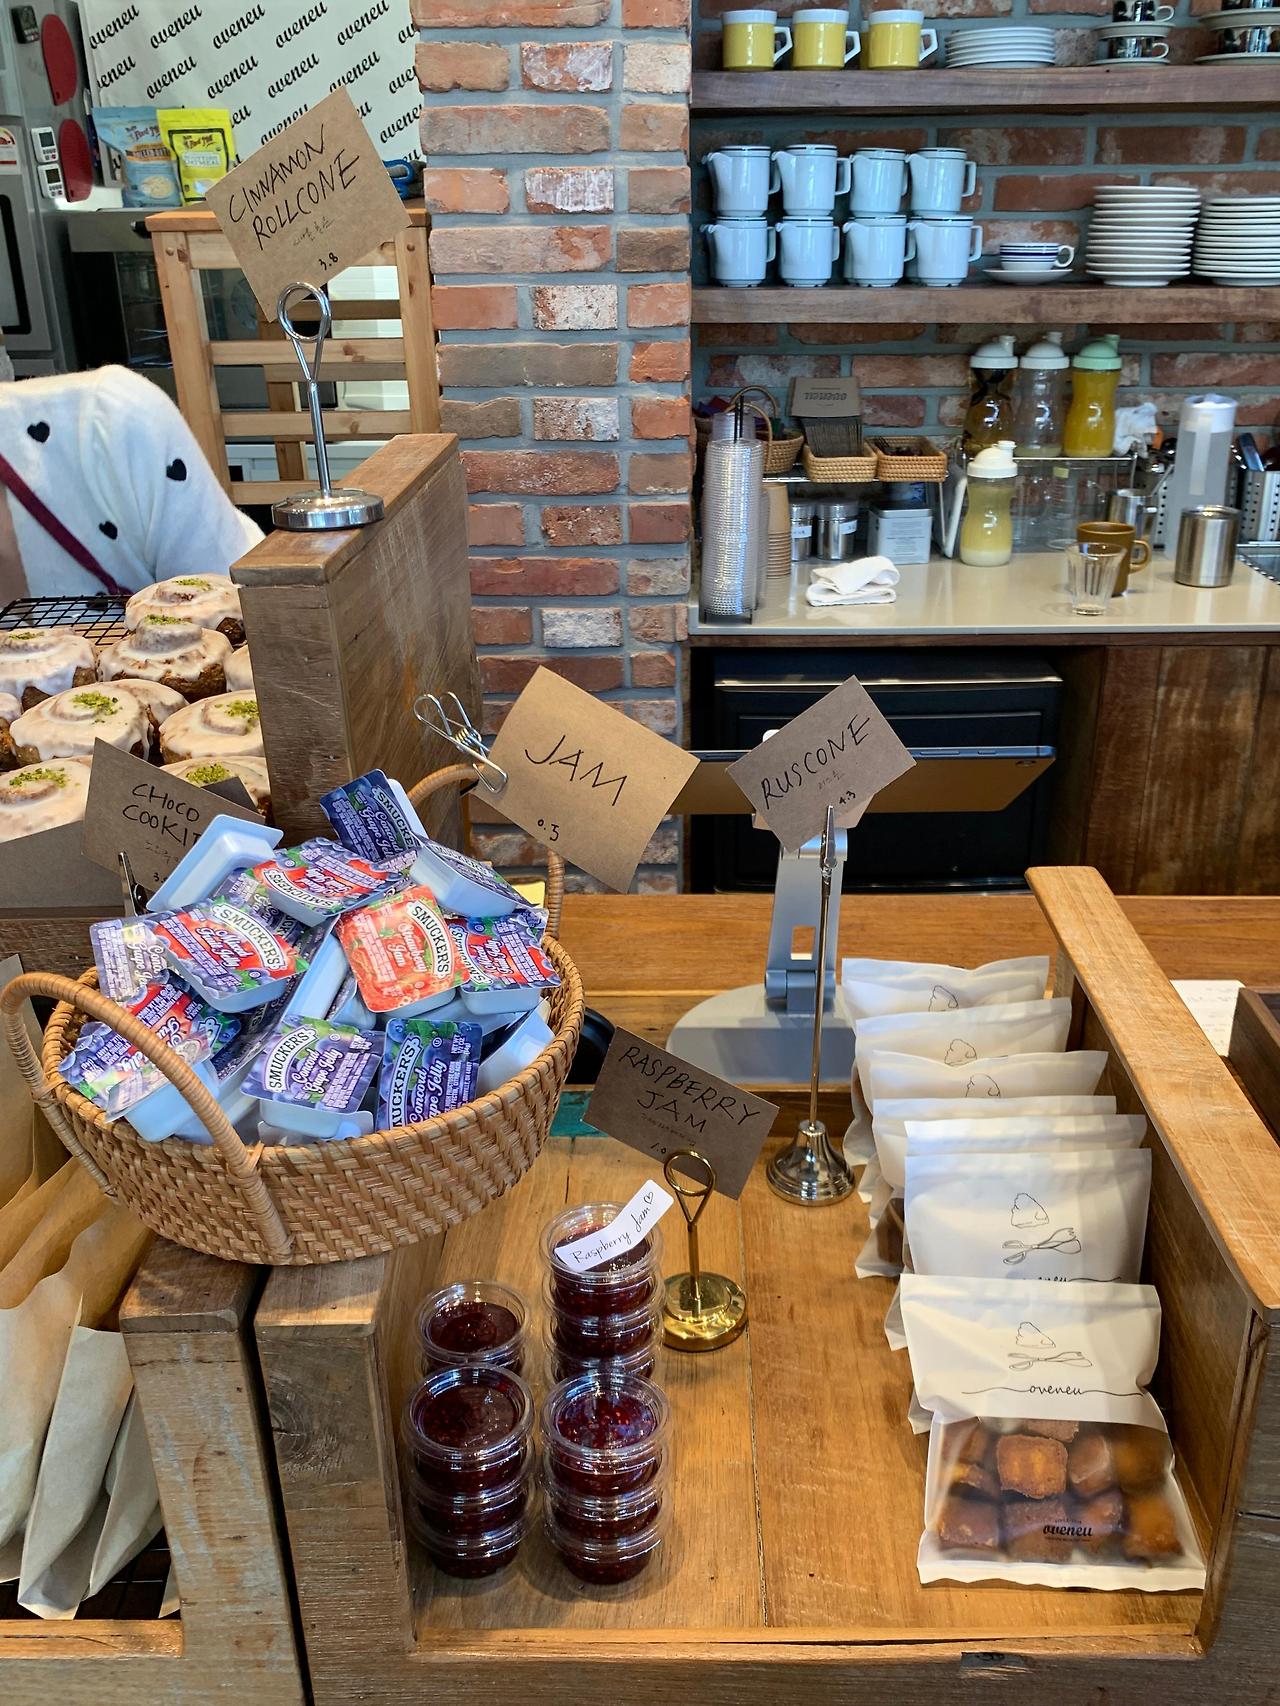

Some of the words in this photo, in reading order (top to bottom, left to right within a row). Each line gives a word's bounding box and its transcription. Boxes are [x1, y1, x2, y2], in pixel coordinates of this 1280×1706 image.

[89, 5, 139, 49] oveneu
[150, 4, 202, 49] oveneu
[213, 4, 265, 49] oveneu
[276, 2, 328, 48] oveneu
[337, 0, 389, 45] oveneu
[97, 56, 137, 89] eneu
[147, 56, 198, 99] oveneu
[207, 55, 259, 99] oveneu
[268, 53, 320, 98] oveneu
[380, 103, 422, 143] ovene
[230, 124, 325, 223] CINNAMON
[252, 149, 360, 251] ROLLCONE
[318, 252, 339, 271] 3.8
[524, 734, 628, 806] JAM
[760, 714, 871, 810] RUSCONE
[132, 783, 200, 822] CHOCO
[376, 838, 394, 858] Jell
[537, 819, 560, 842] 0.5
[219, 909, 281, 967] SMUCKER'S
[387, 943, 408, 967] Jam
[411, 905, 450, 973] SMUCKER'S
[270, 1030, 309, 1089] SMUCKER'S
[291, 1047, 320, 1084] Concord
[303, 1068, 328, 1094] Grape
[318, 1047, 343, 1072] Jelly
[427, 1059, 448, 1096] Jelly
[409, 1066, 428, 1124] Concord
[618, 1046, 761, 1125] RASPBERRY
[637, 1089, 707, 1133] JAM
[569, 1231, 632, 1264] Raspberry
[631, 1206, 651, 1233] Jam
[1028, 1383, 1084, 1396] oveneu
[1042, 1524, 1094, 1537] oveneu
